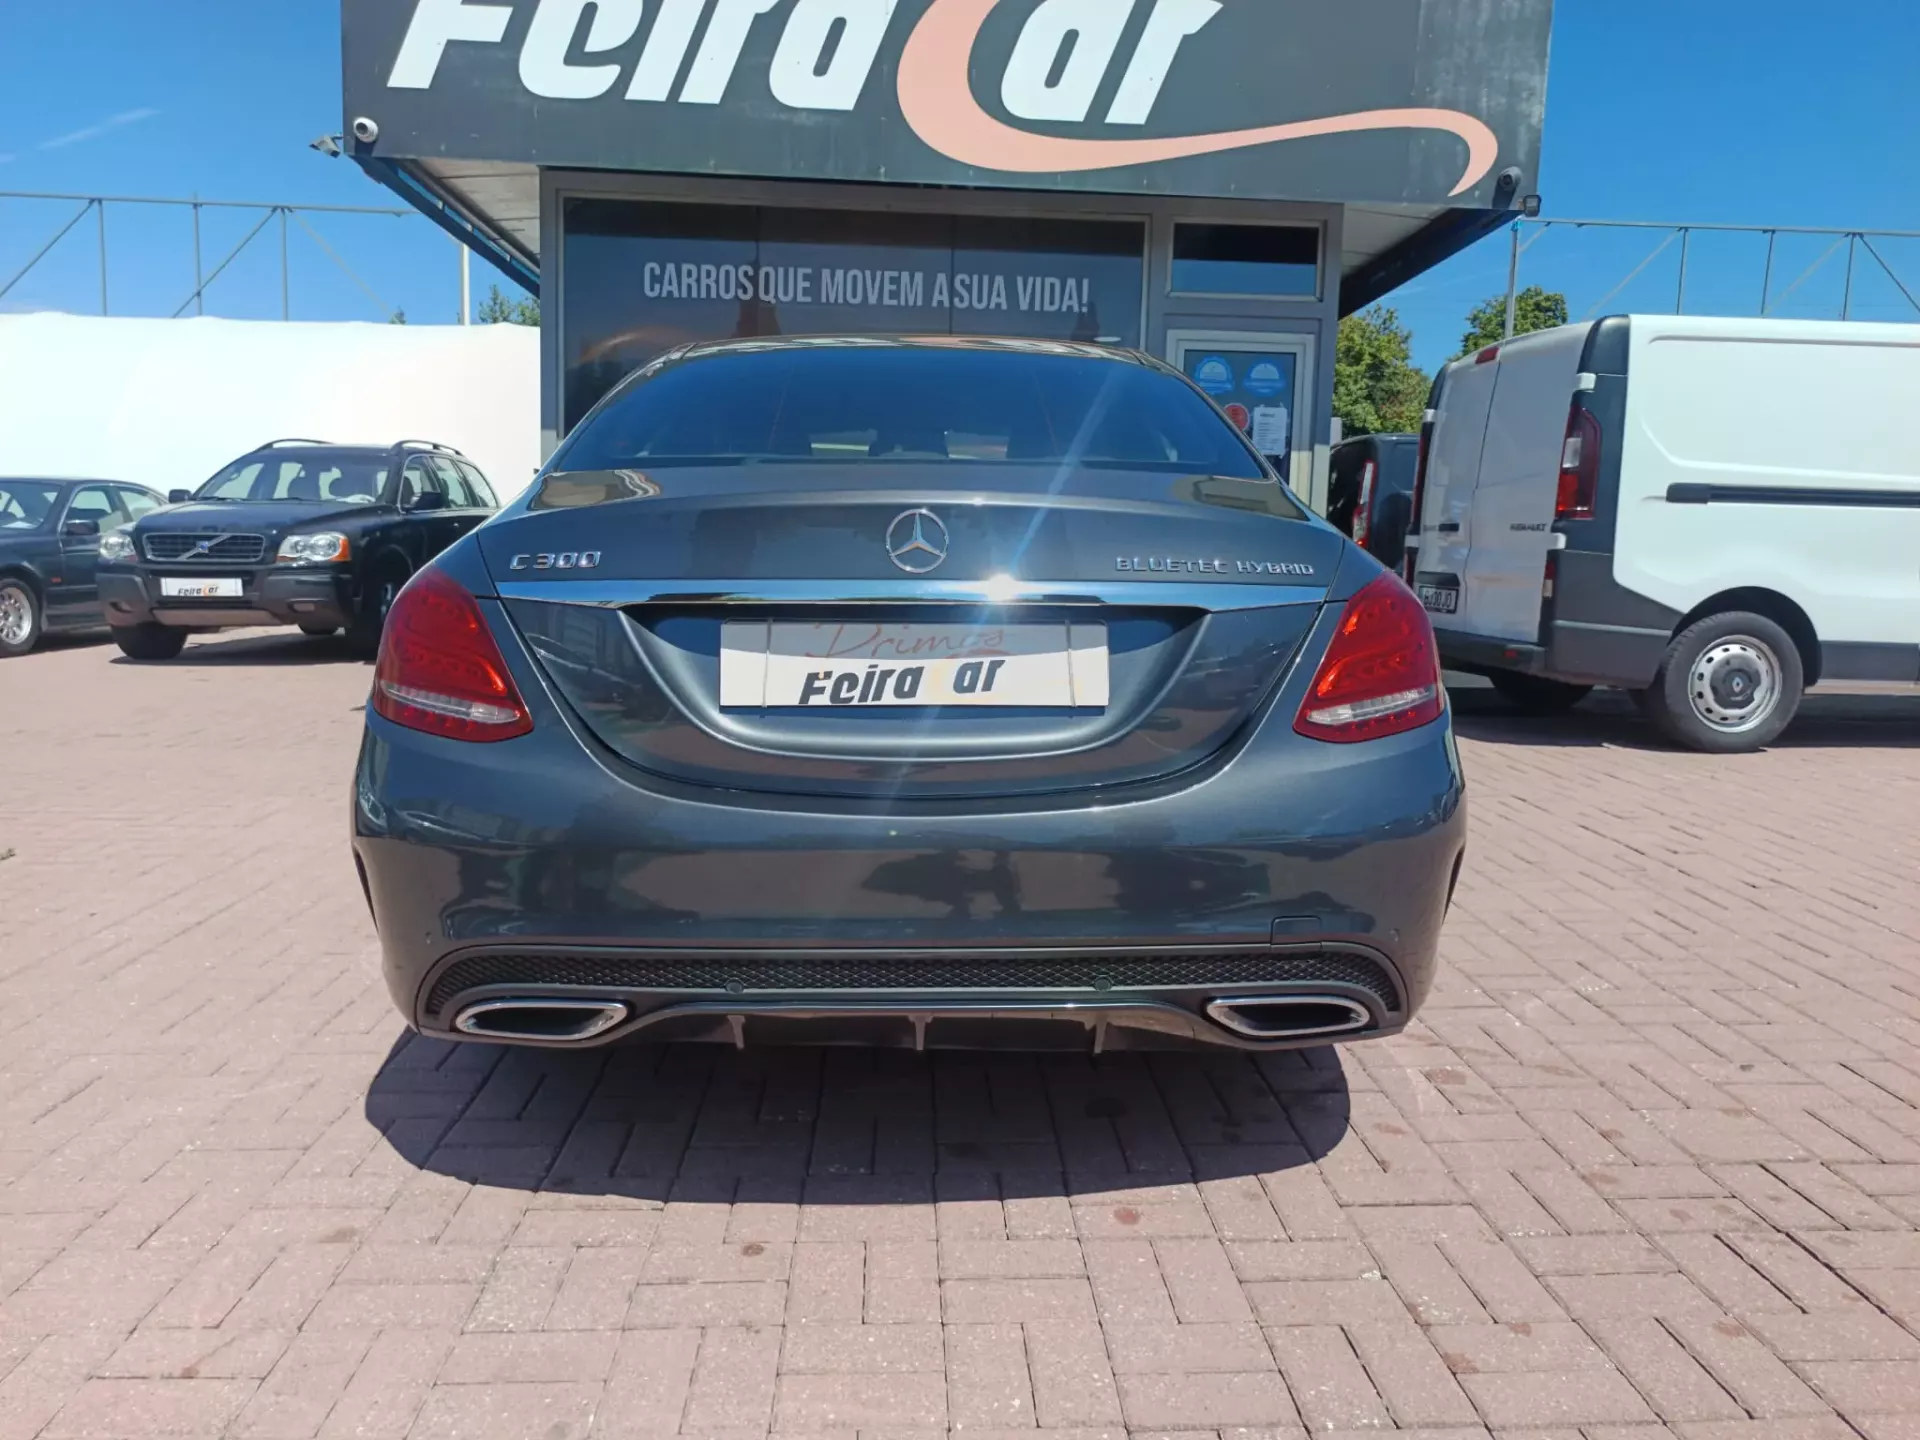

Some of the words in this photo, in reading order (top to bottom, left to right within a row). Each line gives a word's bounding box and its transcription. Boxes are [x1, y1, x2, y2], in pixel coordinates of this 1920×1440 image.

[643, 261, 755, 300] CARROS
[758, 265, 813, 304] QUE
[820, 268, 924, 306] MOVEM
[931, 272, 950, 307] A
[953, 273, 1008, 310] SUA
[1016, 275, 1090, 313] VIDA!
[509, 554, 531, 570] C
[532, 551, 602, 569] 300
[1115, 556, 1229, 574] BLUETEC
[1236, 560, 1315, 576] HYBRID
